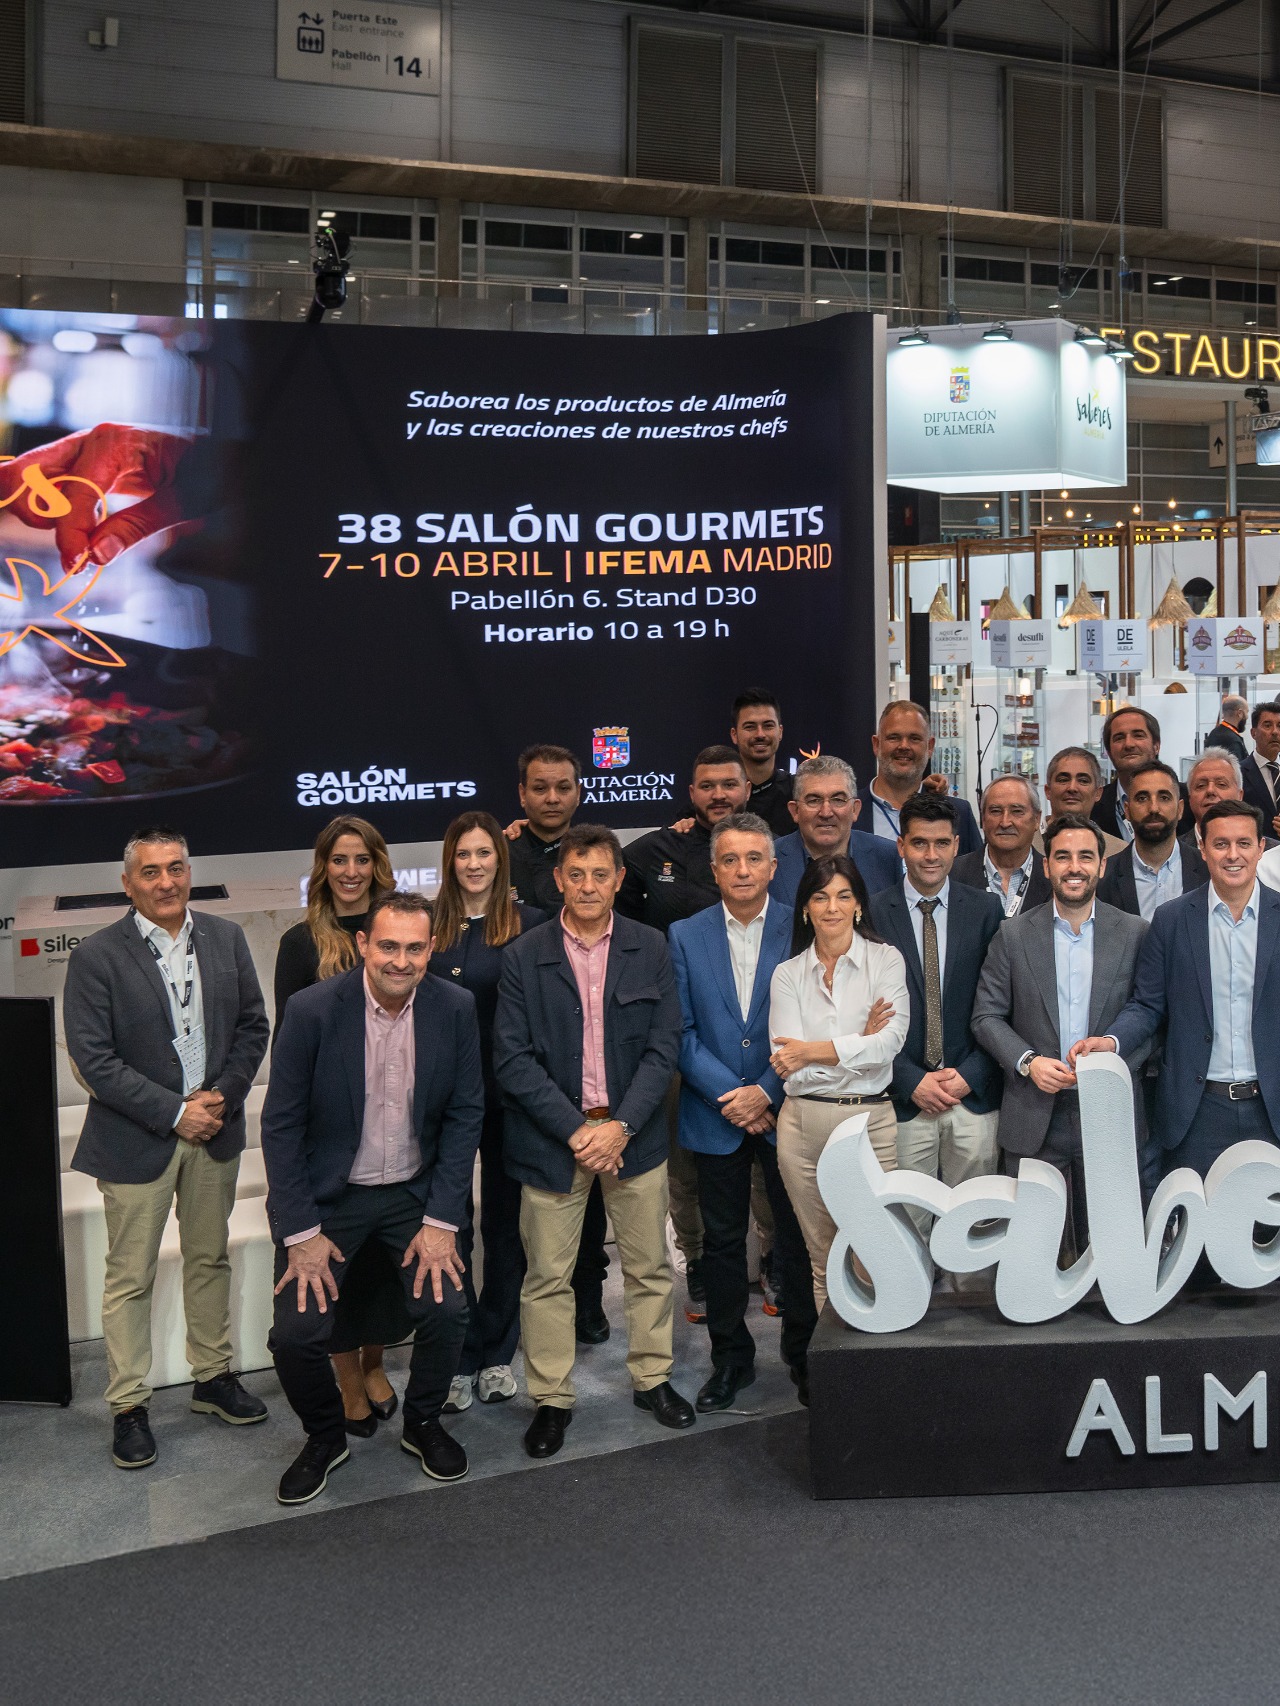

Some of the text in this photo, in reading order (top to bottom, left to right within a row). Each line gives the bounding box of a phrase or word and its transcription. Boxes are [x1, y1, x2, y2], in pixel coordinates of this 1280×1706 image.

[332, 10, 398, 26] Puerta Este
[332, 22, 405, 38] East entrance
[332, 48, 380, 62] Pabellón
[332, 61, 352, 70] Hall
[393, 56, 423, 78] 14
[407, 388, 787, 416] Saborea los productos de Almería
[1076, 393, 1112, 431] sabores
[924, 408, 997, 424] DIPUTACIÓN
[406, 417, 788, 440] y las creaciones de nuestros chefs
[925, 422, 996, 437] DE ALMERÍA
[338, 503, 824, 544] 38 SALÓN GOURMETS
[319, 552, 420, 579] 7-10
[433, 551, 553, 577] ABRIL
[585, 550, 713, 575] IFEMA
[723, 543, 833, 573] MADRID
[451, 586, 757, 611] Pabellón 6. Stand D30
[484, 618, 730, 643] Horario 10 a 19 h
[1117, 629, 1133, 641] DE
[297, 765, 407, 790] SALÓN
[297, 781, 477, 807] GOURMETS
[583, 786, 673, 803] ALMERÍA
